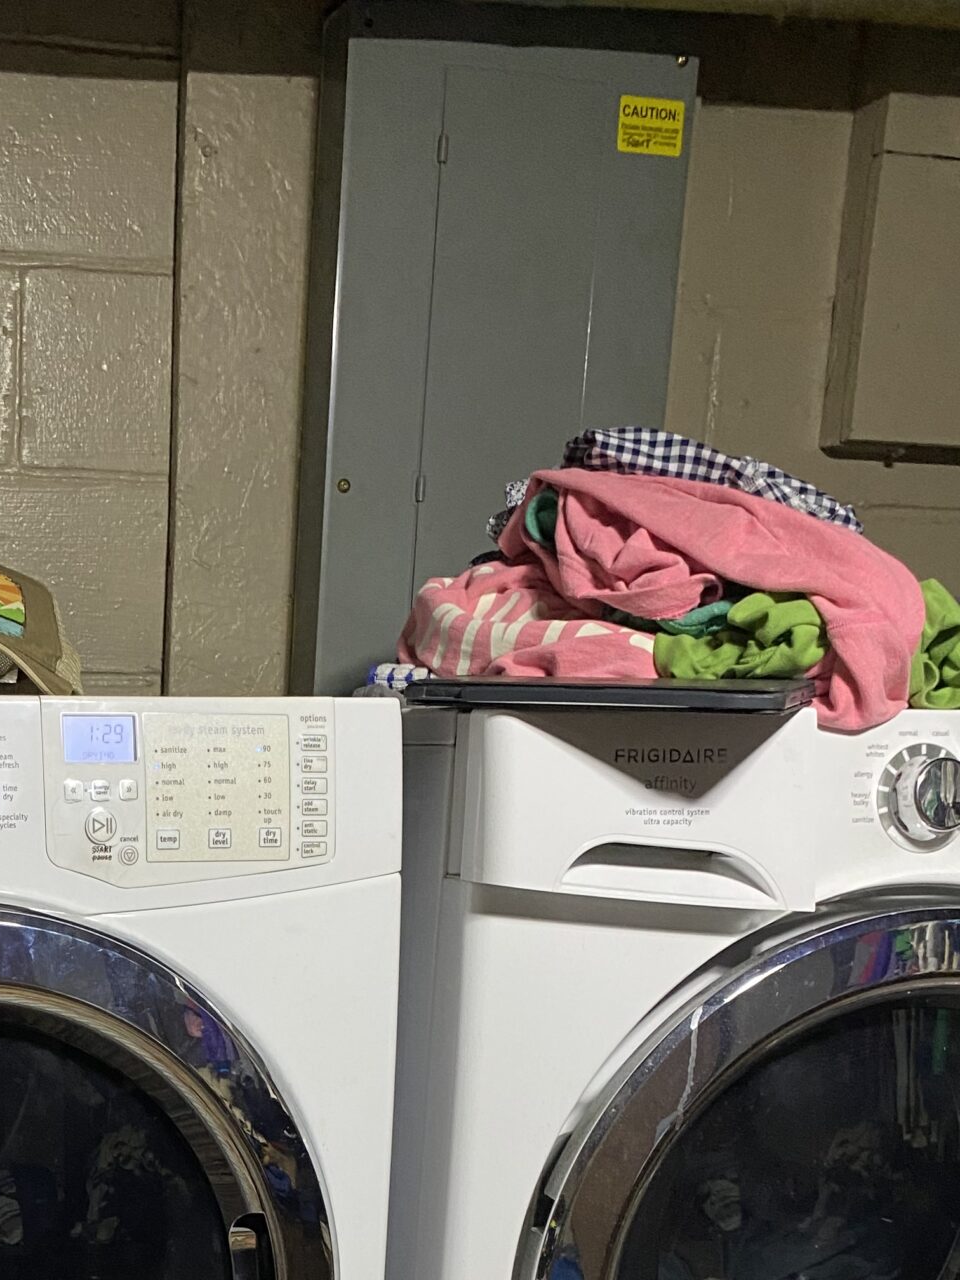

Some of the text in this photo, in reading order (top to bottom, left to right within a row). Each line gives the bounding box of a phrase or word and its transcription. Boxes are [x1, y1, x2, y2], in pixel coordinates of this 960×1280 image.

[623, 104, 680, 122] CAUTION:
[300, 715, 327, 723] options
[90, 724, 123, 744] 1:29
[231, 726, 265, 736] system
[614, 748, 727, 763] FRIGIDAIRE
[161, 762, 176, 771] high
[213, 762, 228, 770] high
[644, 776, 697, 793] affinity
[3, 793, 14, 801] dry
[173, 810, 183, 819] dry
[214, 809, 232, 817] damp
[662, 818, 692, 826] capacity
[214, 831, 226, 839] dry
[265, 830, 276, 838] dry
[160, 835, 177, 843] temp
